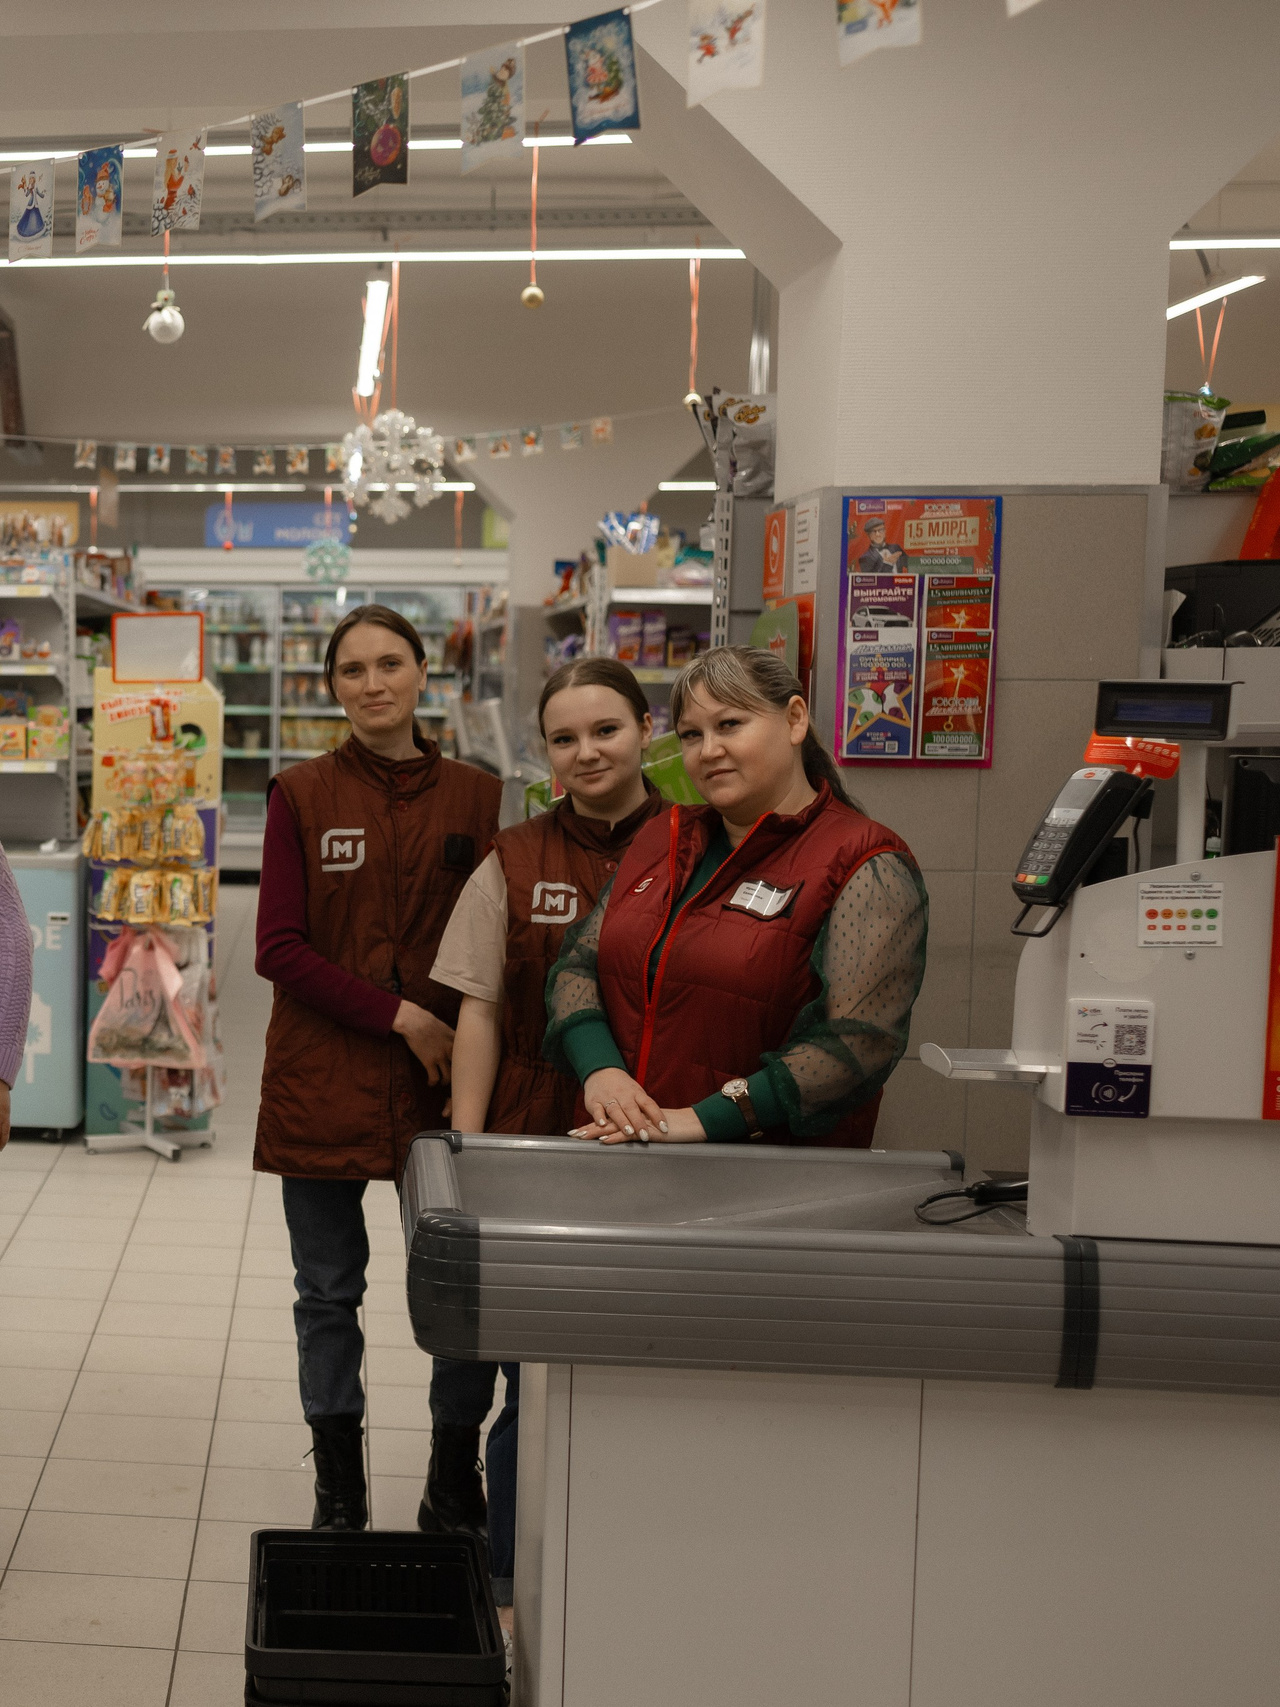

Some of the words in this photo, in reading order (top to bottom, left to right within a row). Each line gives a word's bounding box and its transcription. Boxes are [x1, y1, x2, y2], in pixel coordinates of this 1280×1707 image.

[908, 523, 923, 539] 1,5
[928, 520, 968, 538] МЛРД
[854, 586, 913, 597] ВЫИГРАЙТЕ
